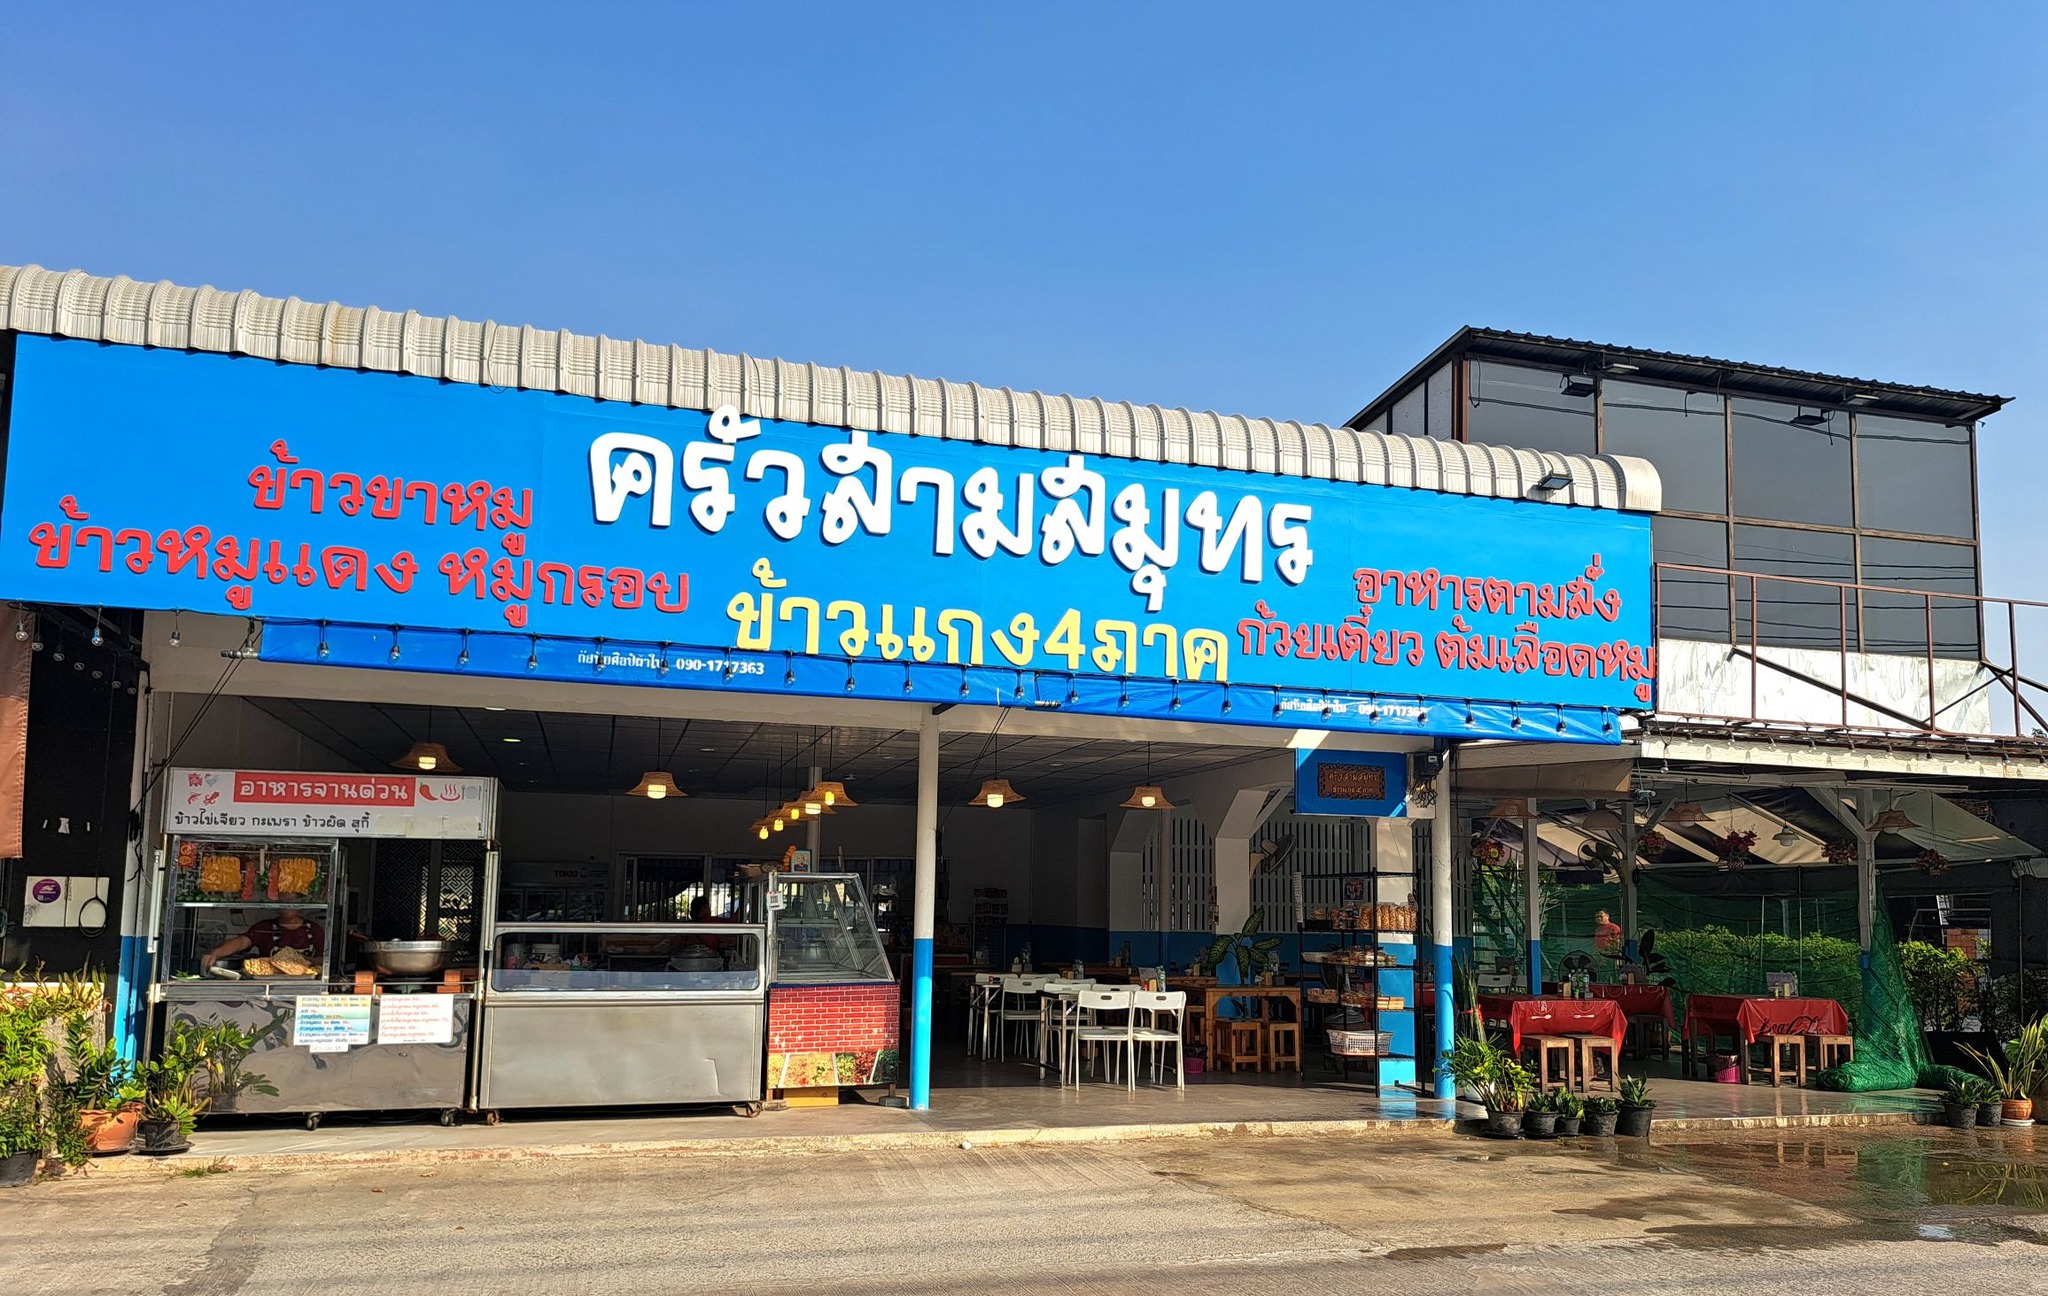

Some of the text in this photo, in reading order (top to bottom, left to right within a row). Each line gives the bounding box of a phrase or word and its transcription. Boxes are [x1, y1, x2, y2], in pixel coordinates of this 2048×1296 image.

[248, 439, 532, 555] ข้าวขาหมู
[590, 404, 1314, 612] ครัวสามสมุทร
[28, 496, 690, 627] ข้าวหมูแดง หมูกรอบ
[1353, 553, 1621, 621] อาหารตามสั่ง
[727, 557, 1228, 681] ข้าวแกง4ภาค
[1436, 614, 1656, 701] ต้มเลือดหมู
[174, 807, 370, 833] ข้าวไข่เจียว กะเพรา ข้าวผัด สุกี้
[239, 776, 409, 800] อาหารจานด่วน
